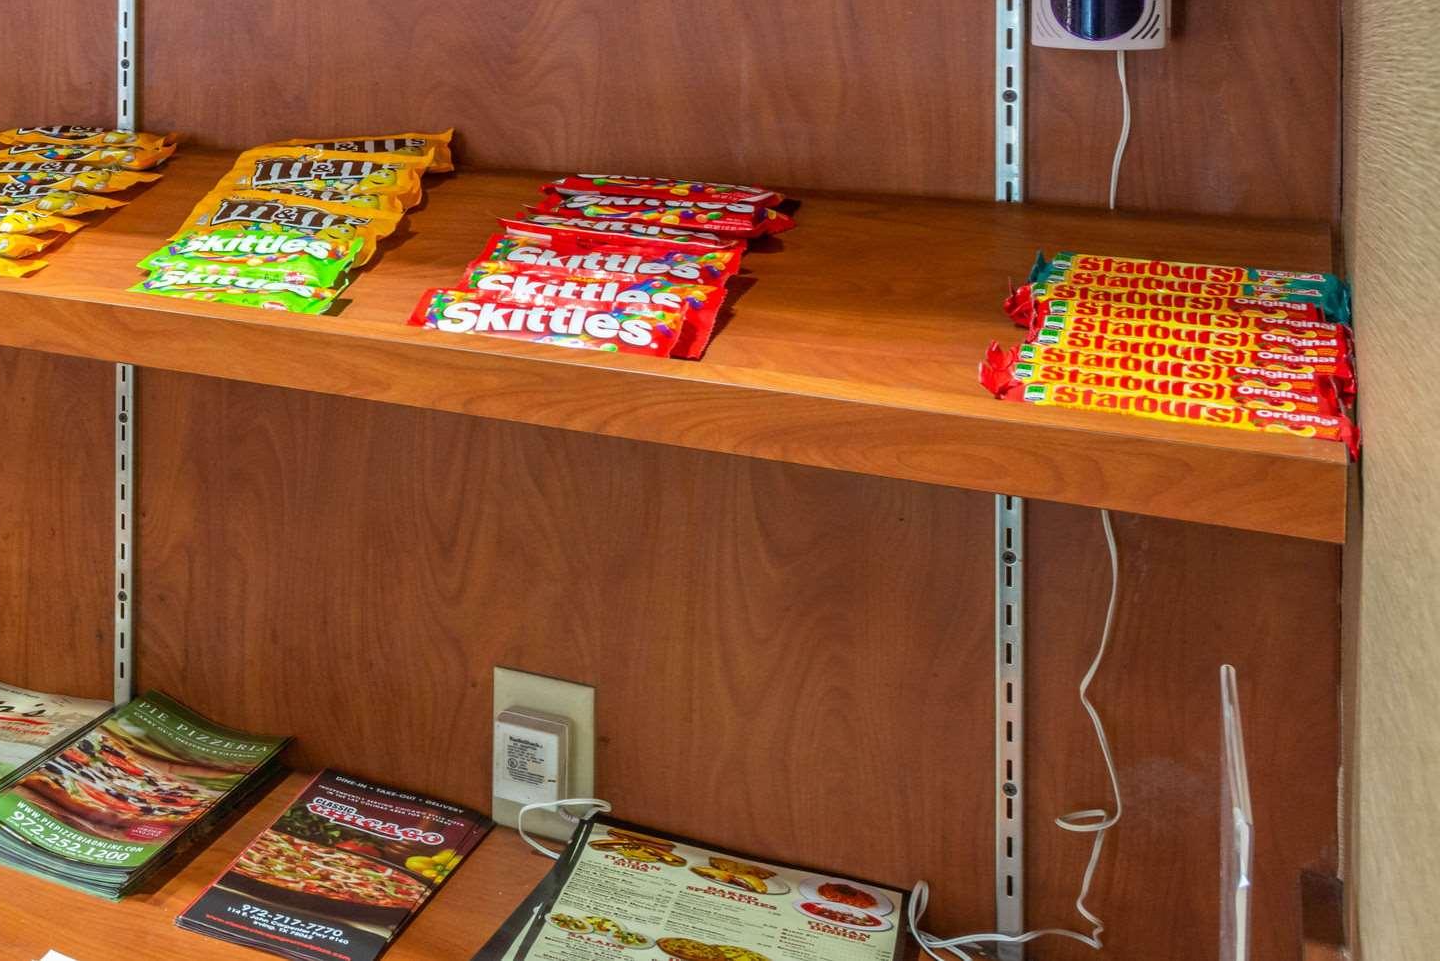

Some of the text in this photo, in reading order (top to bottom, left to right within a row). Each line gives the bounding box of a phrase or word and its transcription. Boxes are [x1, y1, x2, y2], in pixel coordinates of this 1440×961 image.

[180, 233, 333, 261] Skittles
[505, 245, 702, 280] Skittles
[1071, 271, 1241, 298] Starburst
[1077, 255, 1247, 283] Starburst
[476, 273, 683, 308] Skittles
[1052, 283, 1308, 312] Starburst Original
[442, 301, 655, 348] Skittles
[1071, 316, 1338, 348] Starburst Original
[1076, 300, 1337, 330] Starburst Original
[1041, 346, 1316, 381] Starburst Original
[1066, 331, 1337, 365] Starburst Original
[1039, 363, 1319, 404] Starburst Original
[1052, 384, 1340, 428] Starburst Original
[138, 701, 269, 753] PIE PIZZERIA
[315, 797, 355, 813] CLASSIC
[335, 775, 465, 814] DINE-IN TAKE-OUT DELIVERY
[11, 810, 130, 862] 972.252.1200
[16, 800, 145, 854] WWW.PIEPIZZERIAONLINE.COM
[308, 802, 445, 845] CHICAGO
[604, 854, 662, 872] ITALIAN
[241, 903, 344, 938] 972-717-7770
[249, 913, 270, 925] John
